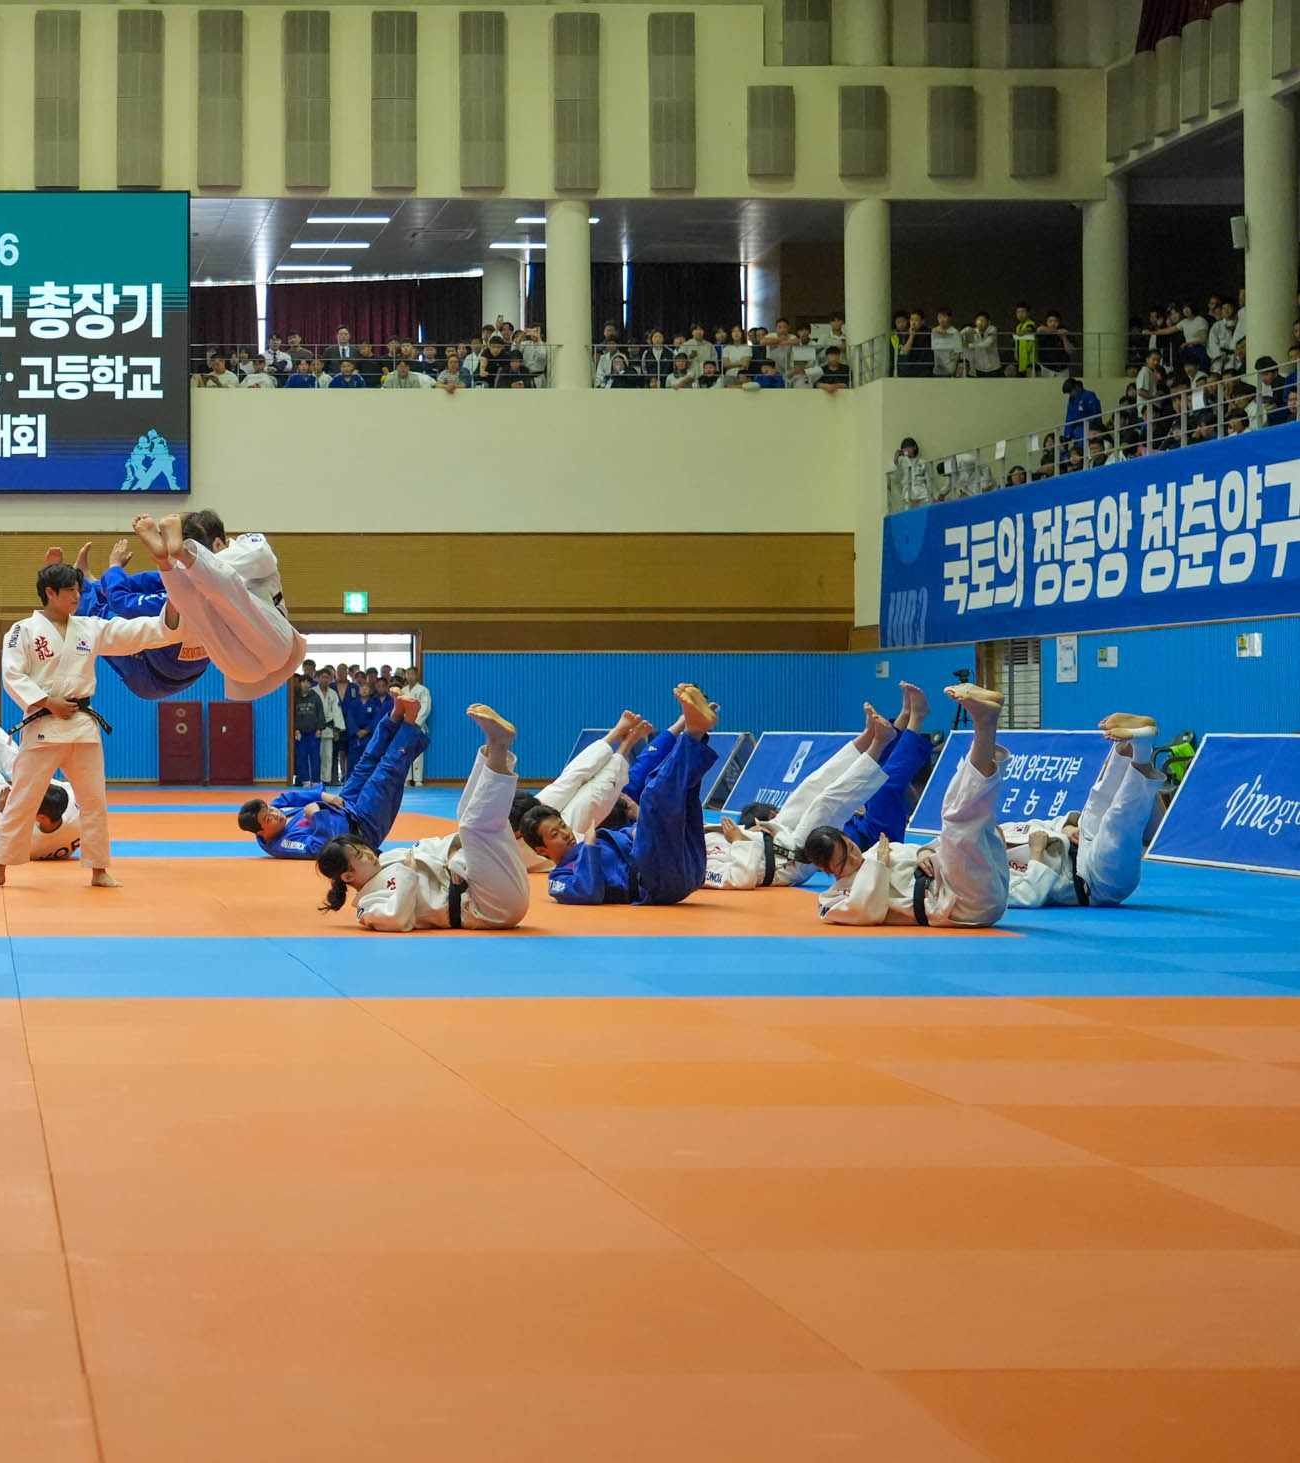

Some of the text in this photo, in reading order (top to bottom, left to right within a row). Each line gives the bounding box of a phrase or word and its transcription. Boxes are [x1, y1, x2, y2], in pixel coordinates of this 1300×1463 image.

[26, 281, 163, 340] 총장기
[943, 458, 1300, 615] 국토의 정중앙 청춘양구
[1023, 754, 1084, 783] 양구군지부
